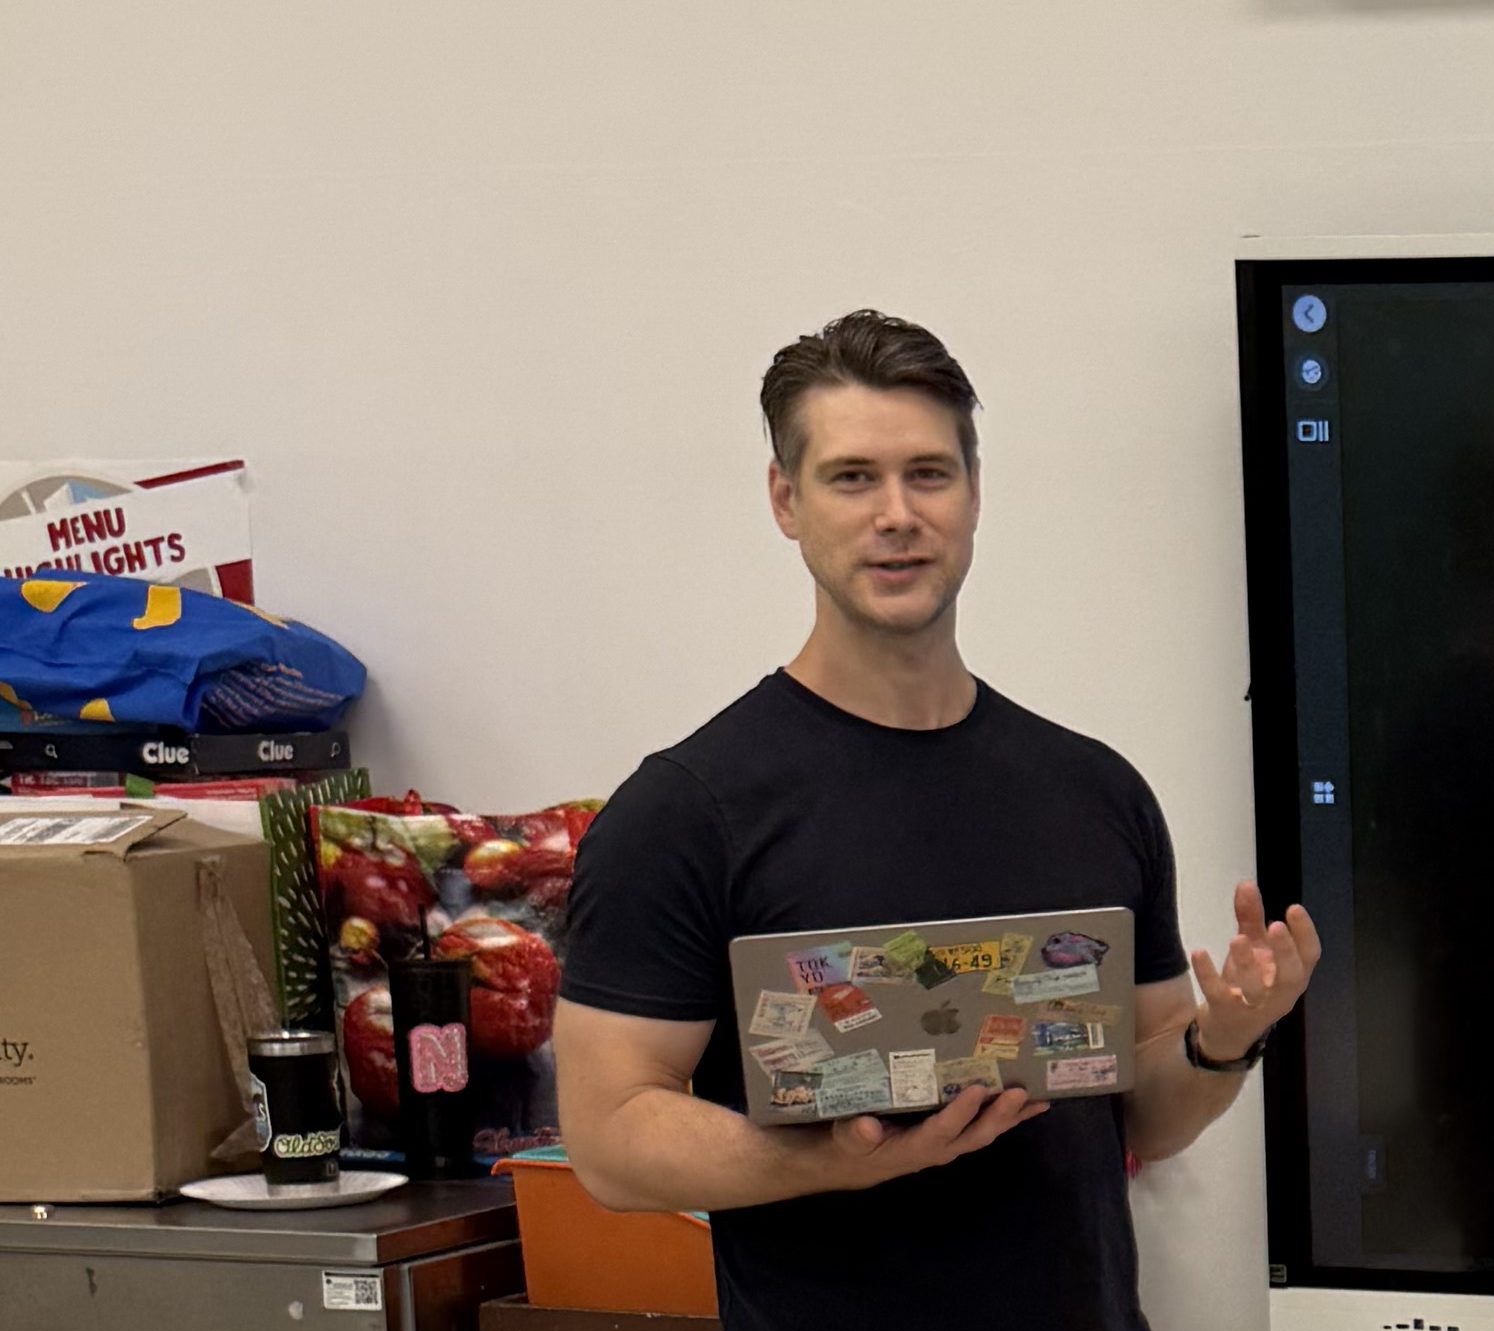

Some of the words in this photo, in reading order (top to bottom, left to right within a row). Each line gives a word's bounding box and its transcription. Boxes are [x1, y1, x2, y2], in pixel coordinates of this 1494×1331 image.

[47, 507, 126, 552] MENU
[142, 742, 189, 764] Clue
[258, 740, 294, 761] Clue
[0, 1038, 34, 1067] ty.
[409, 1023, 468, 1092] N
